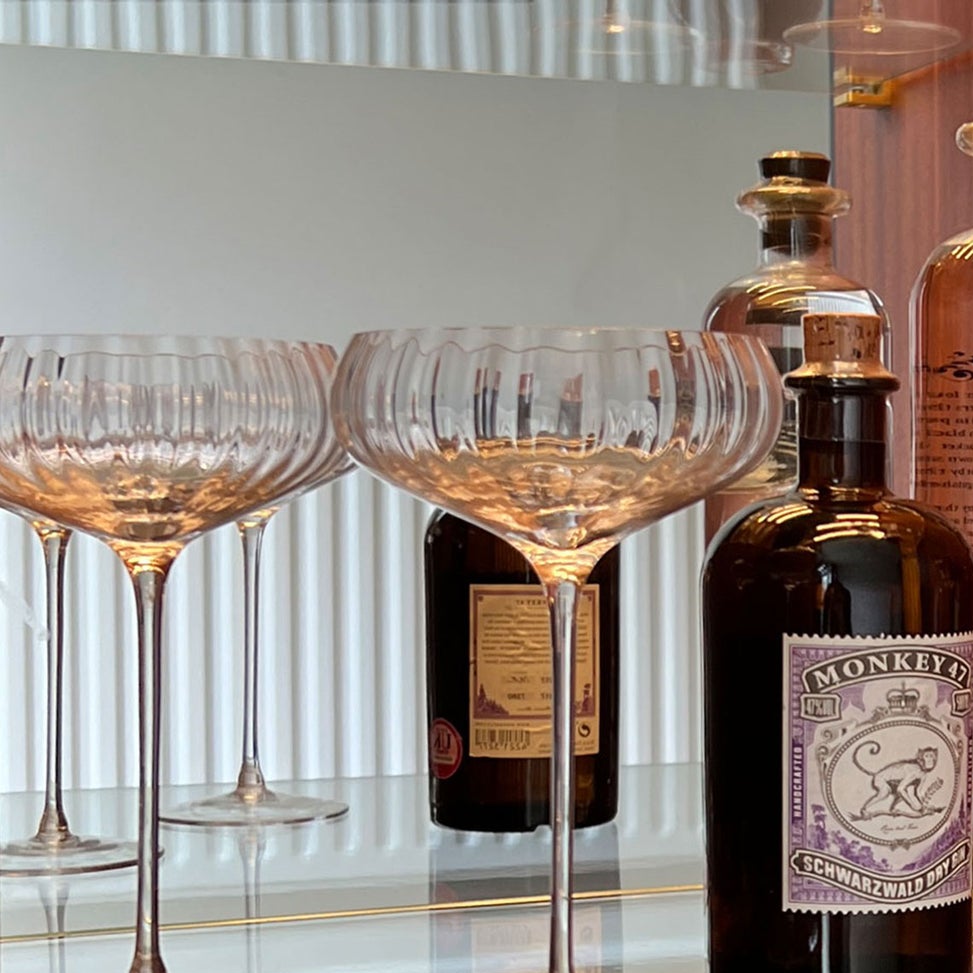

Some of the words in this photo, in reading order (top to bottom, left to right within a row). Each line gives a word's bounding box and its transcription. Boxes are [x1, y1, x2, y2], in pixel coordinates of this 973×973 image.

[812, 651, 945, 690] MONKEY
[948, 661, 968, 683] 47
[803, 855, 924, 899] SCHWARZWALD
[926, 857, 951, 888] DRY
